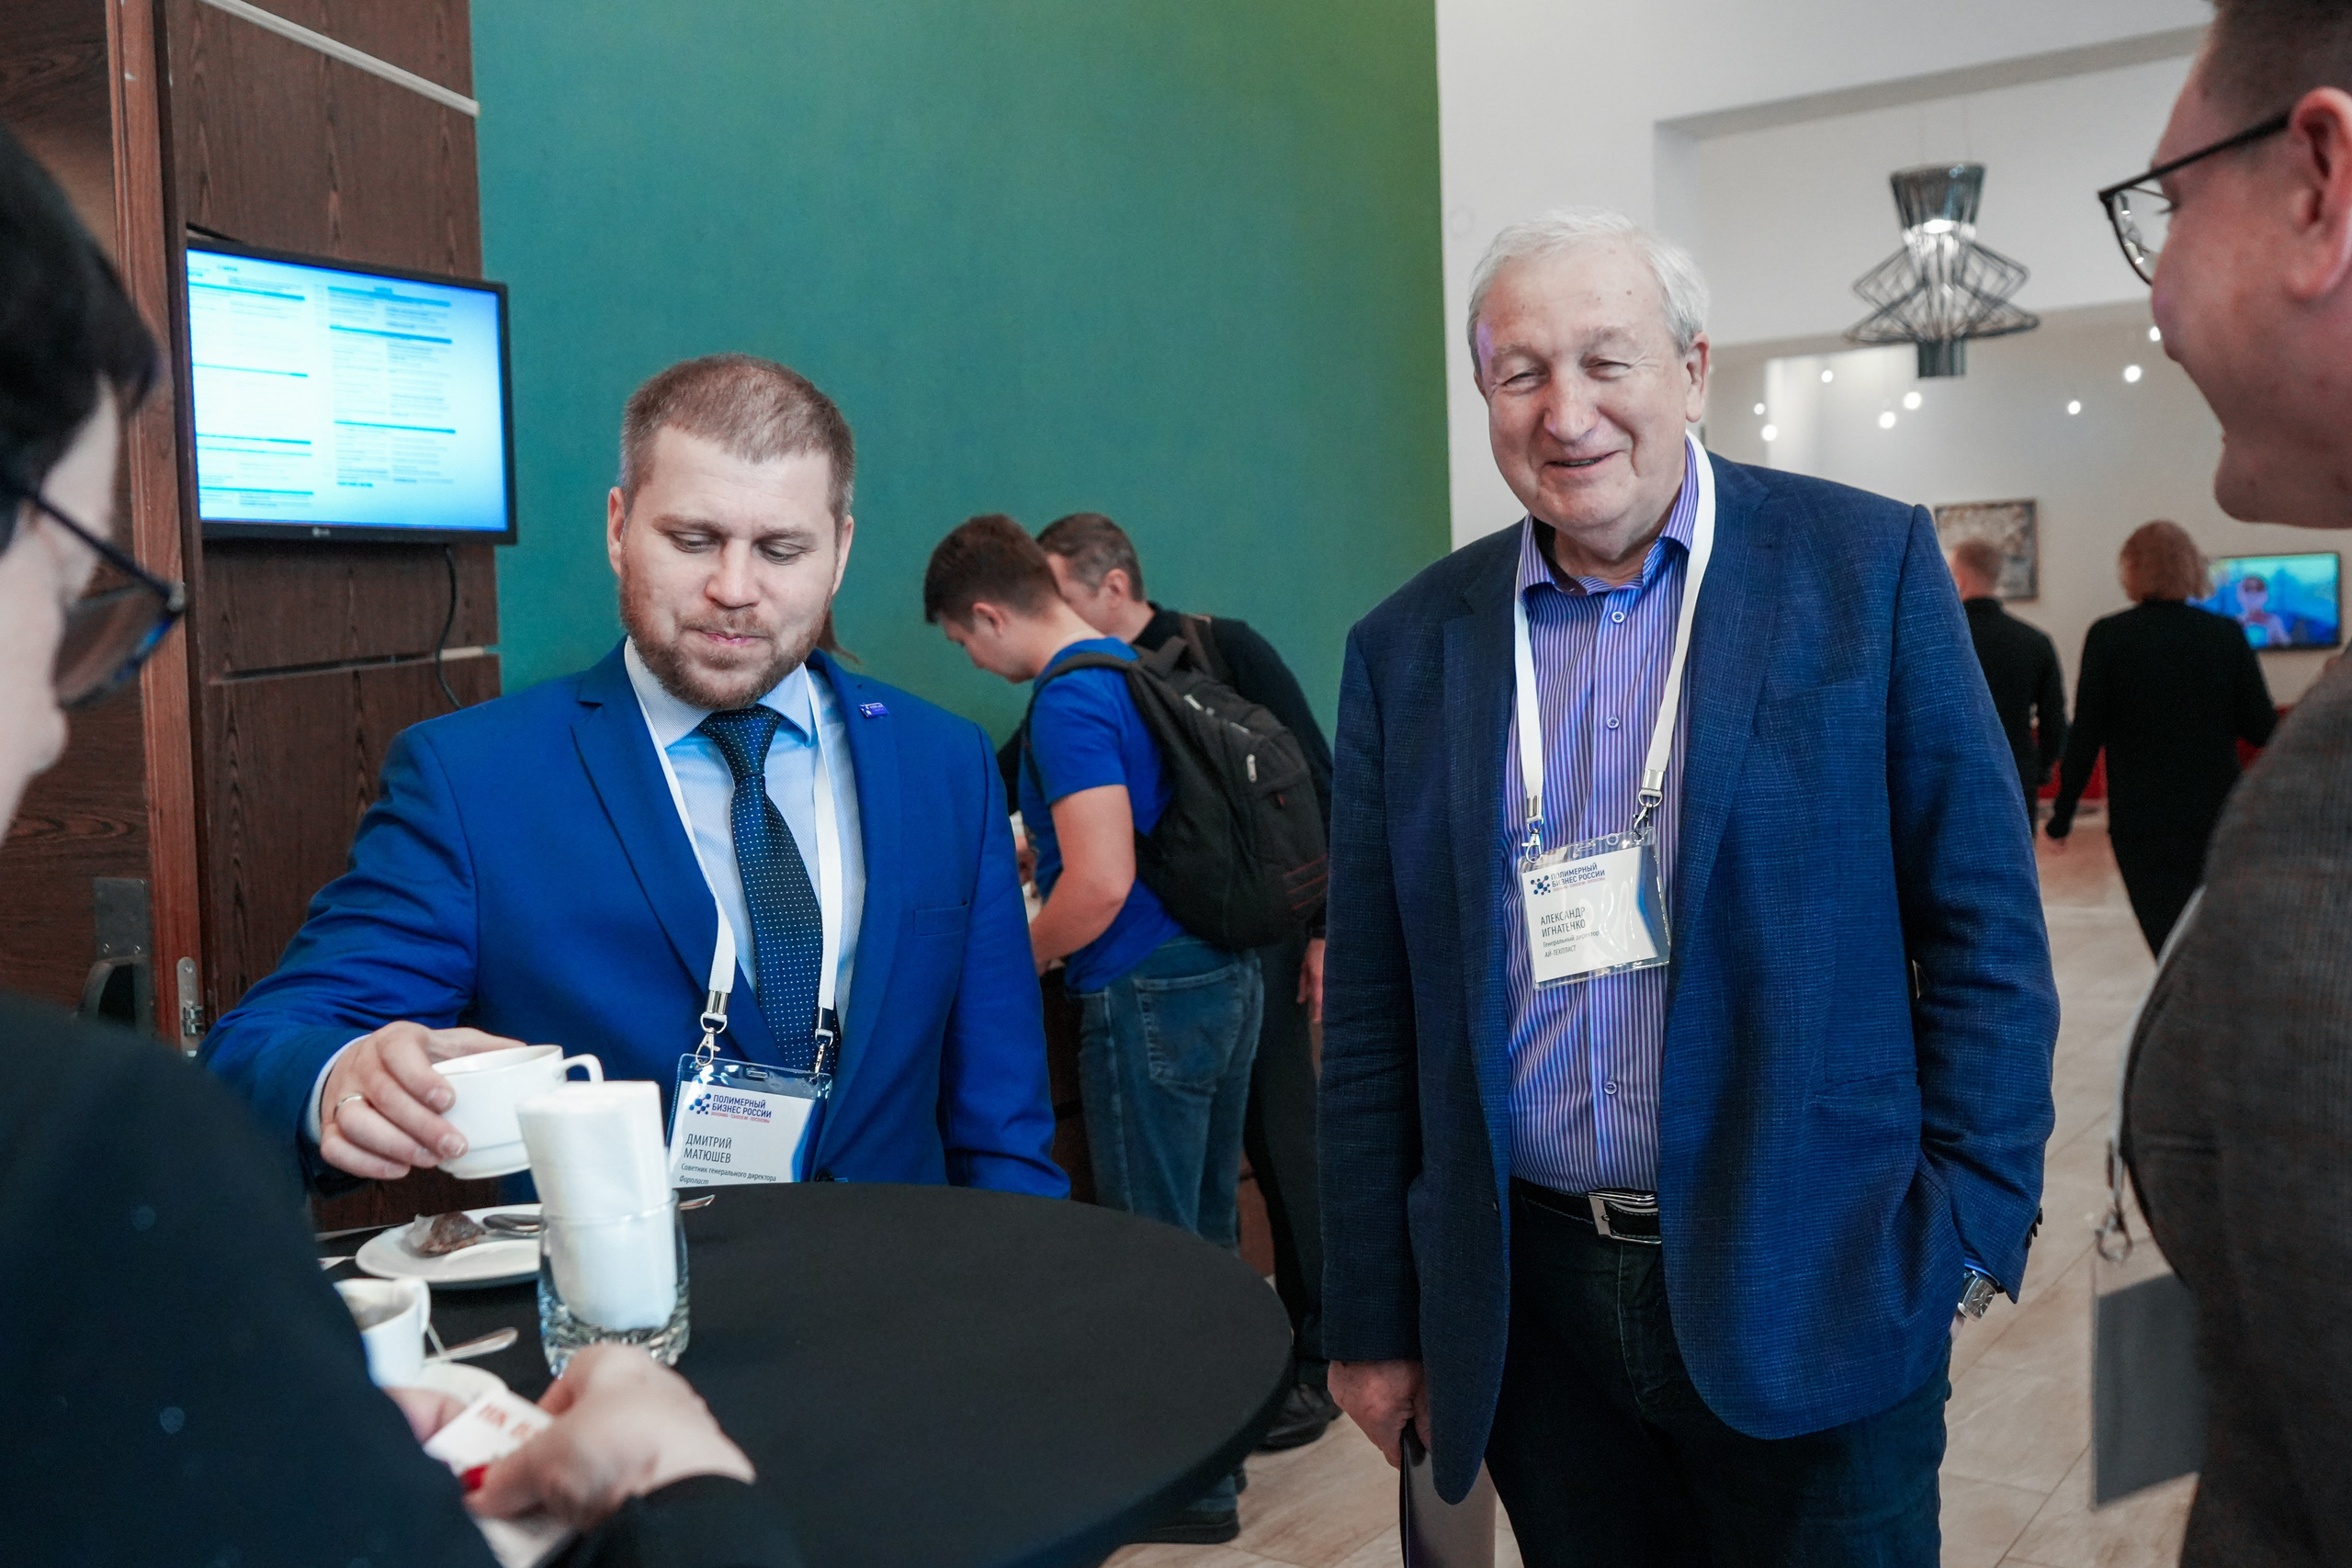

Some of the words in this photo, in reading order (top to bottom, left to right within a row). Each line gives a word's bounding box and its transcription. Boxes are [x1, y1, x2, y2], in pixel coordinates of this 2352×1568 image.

[1551, 863, 1598, 880] ПОЛИМЕРНЫЙ
[1552, 875, 1577, 887] БИЗНЕС
[1578, 869, 1605, 881] РОССИИ
[1541, 907, 1586, 926] АЛЕКСАНДР
[1542, 919, 1586, 938] ИГНАТЕНКО
[1576, 931, 1600, 941] диретор
[713, 1094, 766, 1109] ПОЛИМЕРНЫЙ
[711, 1102, 741, 1114] БИЗНЕС
[742, 1107, 772, 1119] РОССИИ
[685, 1133, 732, 1149] ДМИТРИЙ
[684, 1147, 731, 1164] МАТЮШЕВ
[681, 1162, 708, 1173] Советник
[708, 1168, 747, 1179] генерального
[746, 1172, 776, 1182] директора
